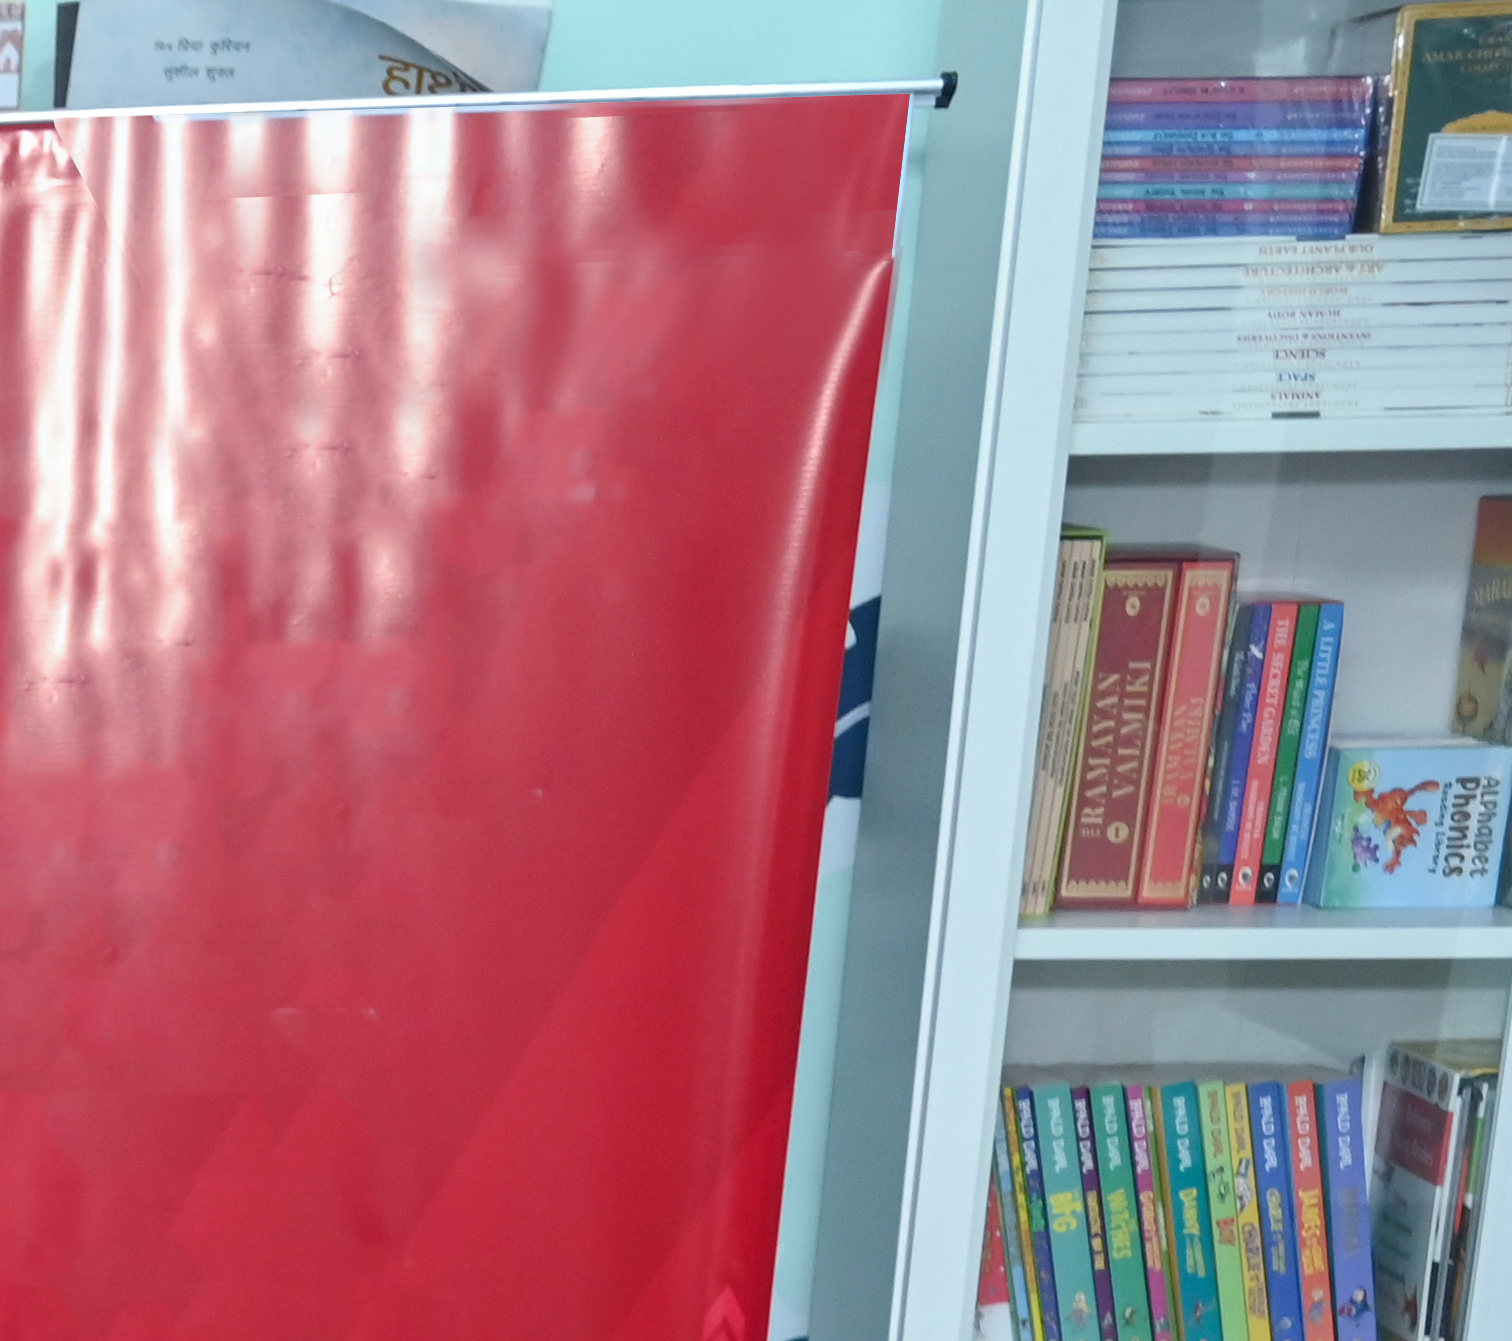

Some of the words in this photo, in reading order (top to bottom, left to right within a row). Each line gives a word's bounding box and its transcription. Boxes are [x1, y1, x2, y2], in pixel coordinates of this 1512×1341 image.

[1258, 246, 1297, 255] EARTH
[1360, 262, 1384, 272] ART
[1272, 349, 1326, 359] SCIENCE
[1276, 372, 1315, 382] SPACE
[1270, 391, 1321, 400] ANIMALS
[1273, 619, 1290, 648] THE
[1323, 619, 1335, 631] A
[1314, 636, 1334, 689] LITTLE
[1265, 652, 1285, 706] SECRET
[1111, 661, 1151, 798] VALMIKI
[1257, 707, 1276, 765] GARDEN
[1304, 689, 1325, 760] PRINCESS
[1080, 672, 1120, 824] RAMAYAN
